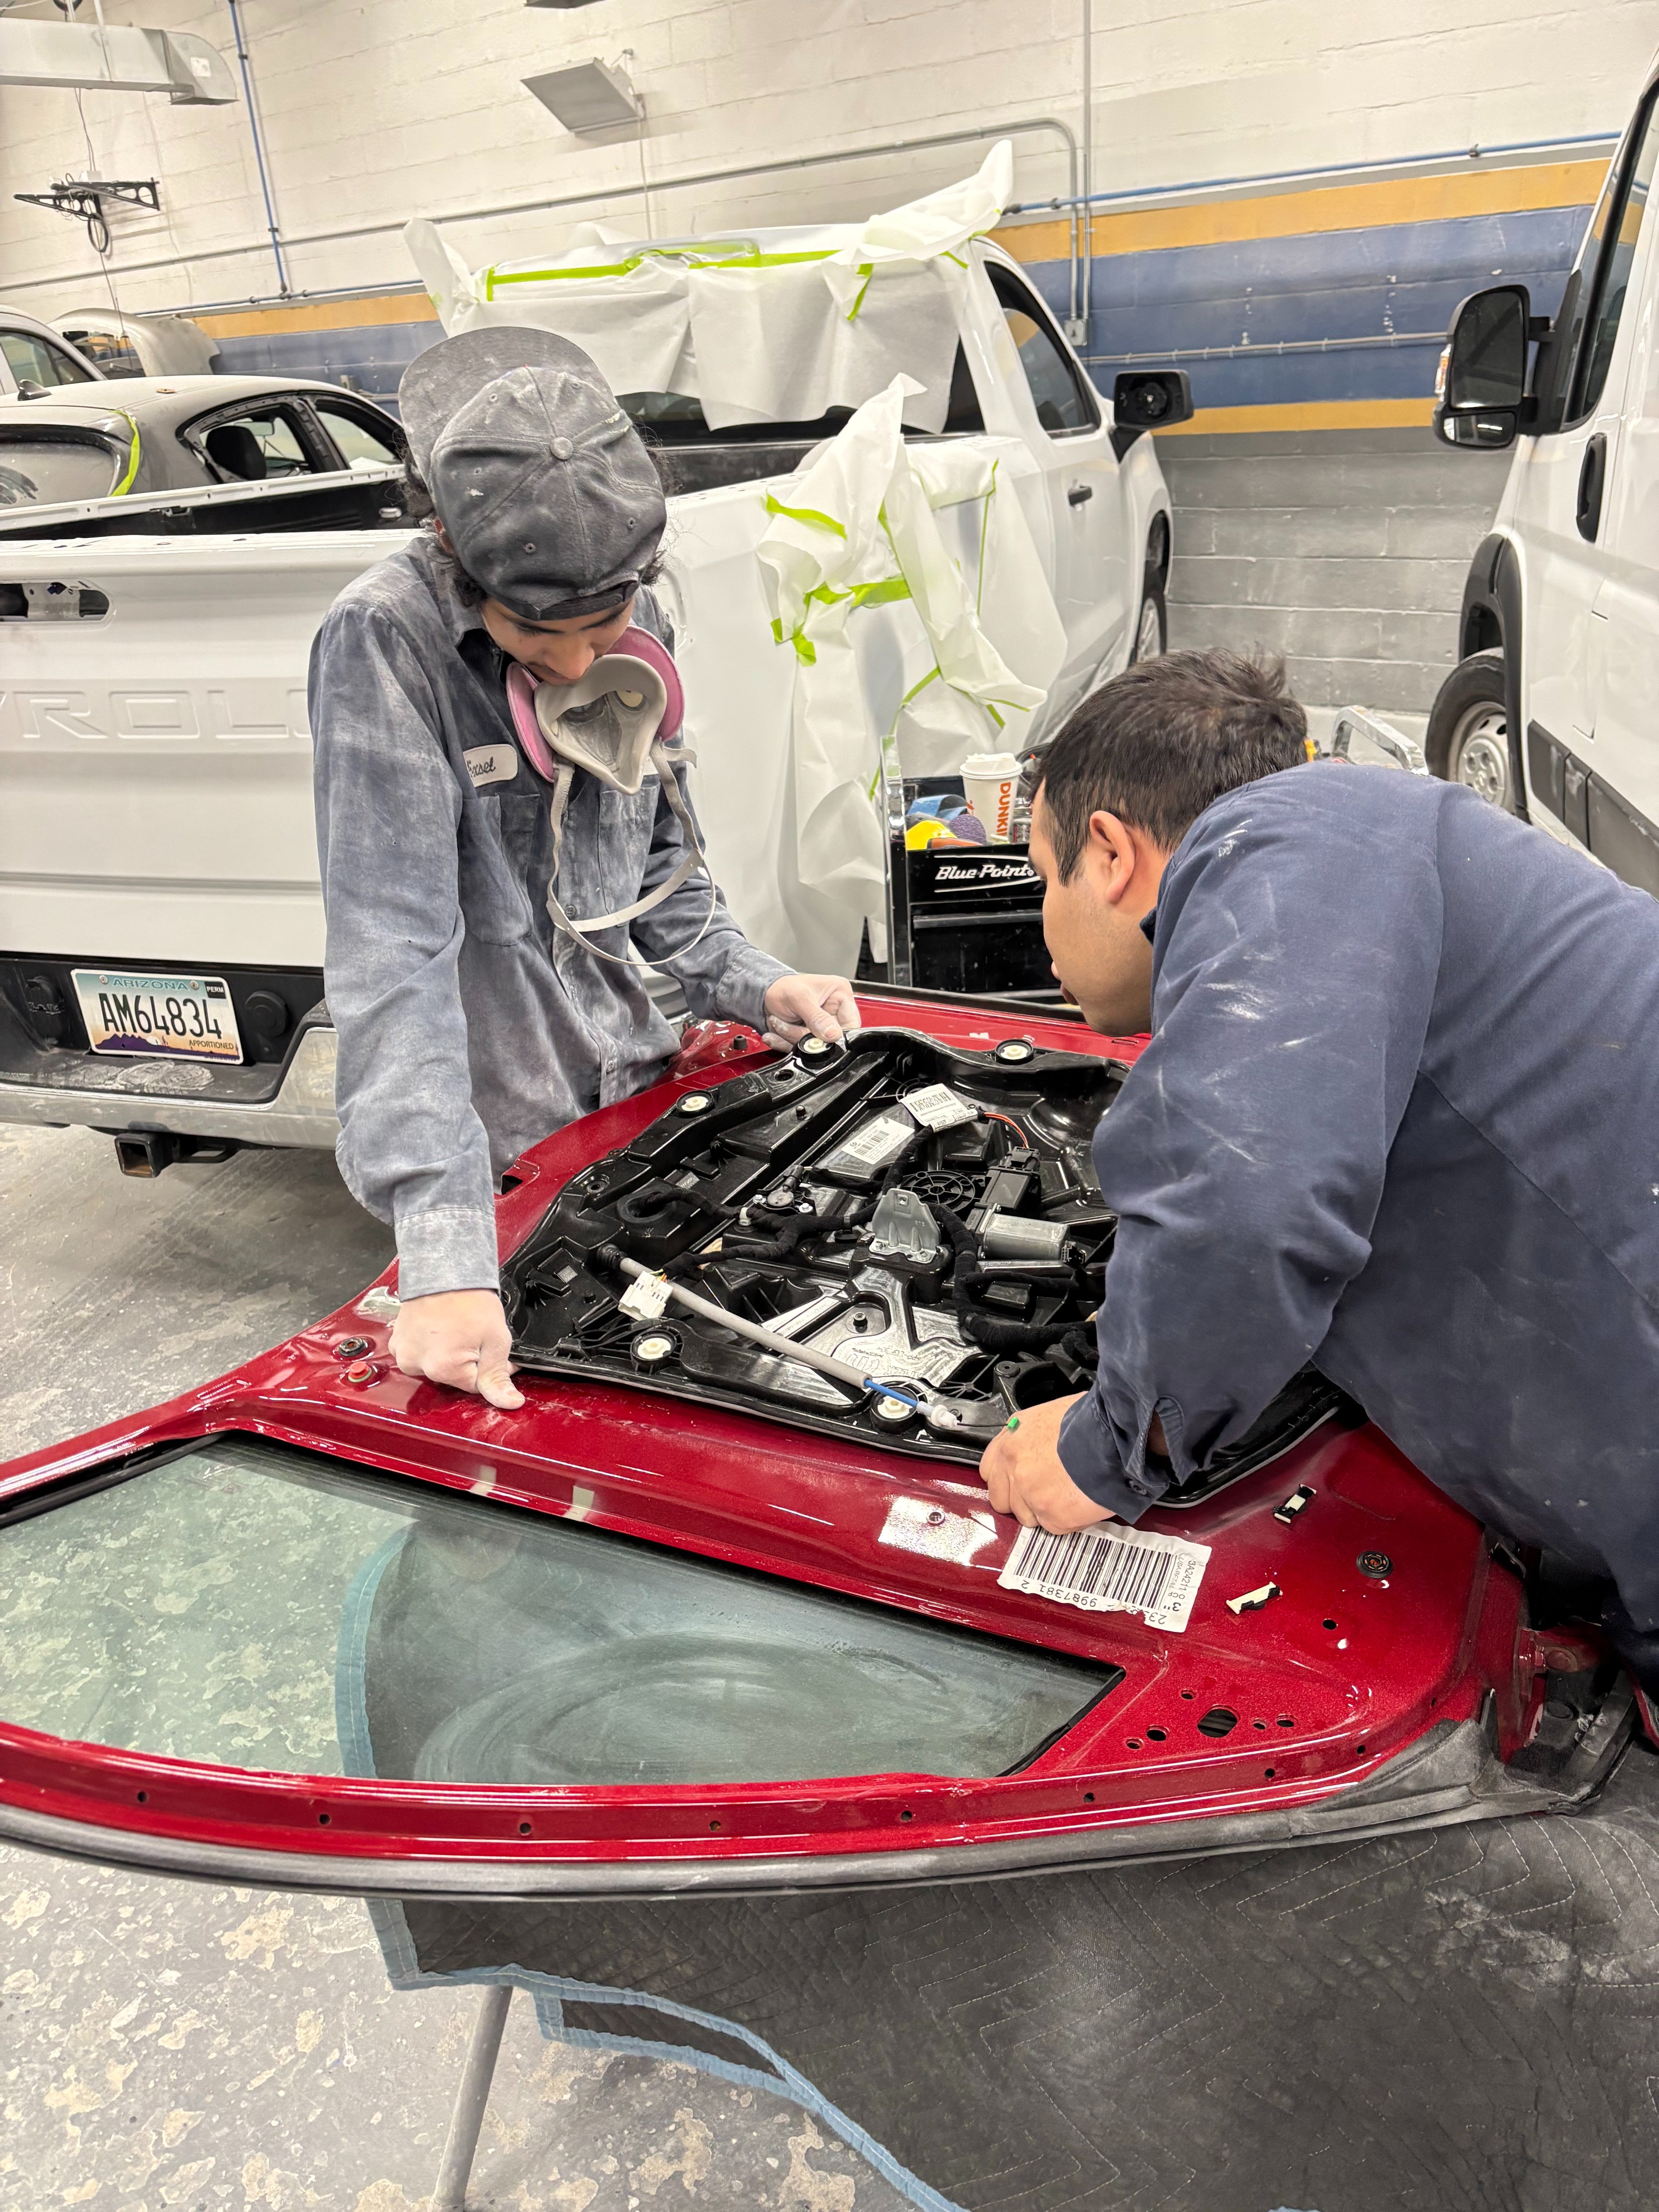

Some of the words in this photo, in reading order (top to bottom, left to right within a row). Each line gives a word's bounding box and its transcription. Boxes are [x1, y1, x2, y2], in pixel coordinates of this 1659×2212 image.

[0, 690, 310, 738] ROL
[113, 978, 189, 991] ARIZONA
[206, 985, 224, 993] PERM
[98, 993, 222, 1039] AM64834
[189, 1039, 234, 1050] APPORTIONED
[1021, 1580, 1030, 1589] 2
[1179, 1560, 1196, 1591] 3A24211
[1039, 1583, 1097, 1607] 9987381
